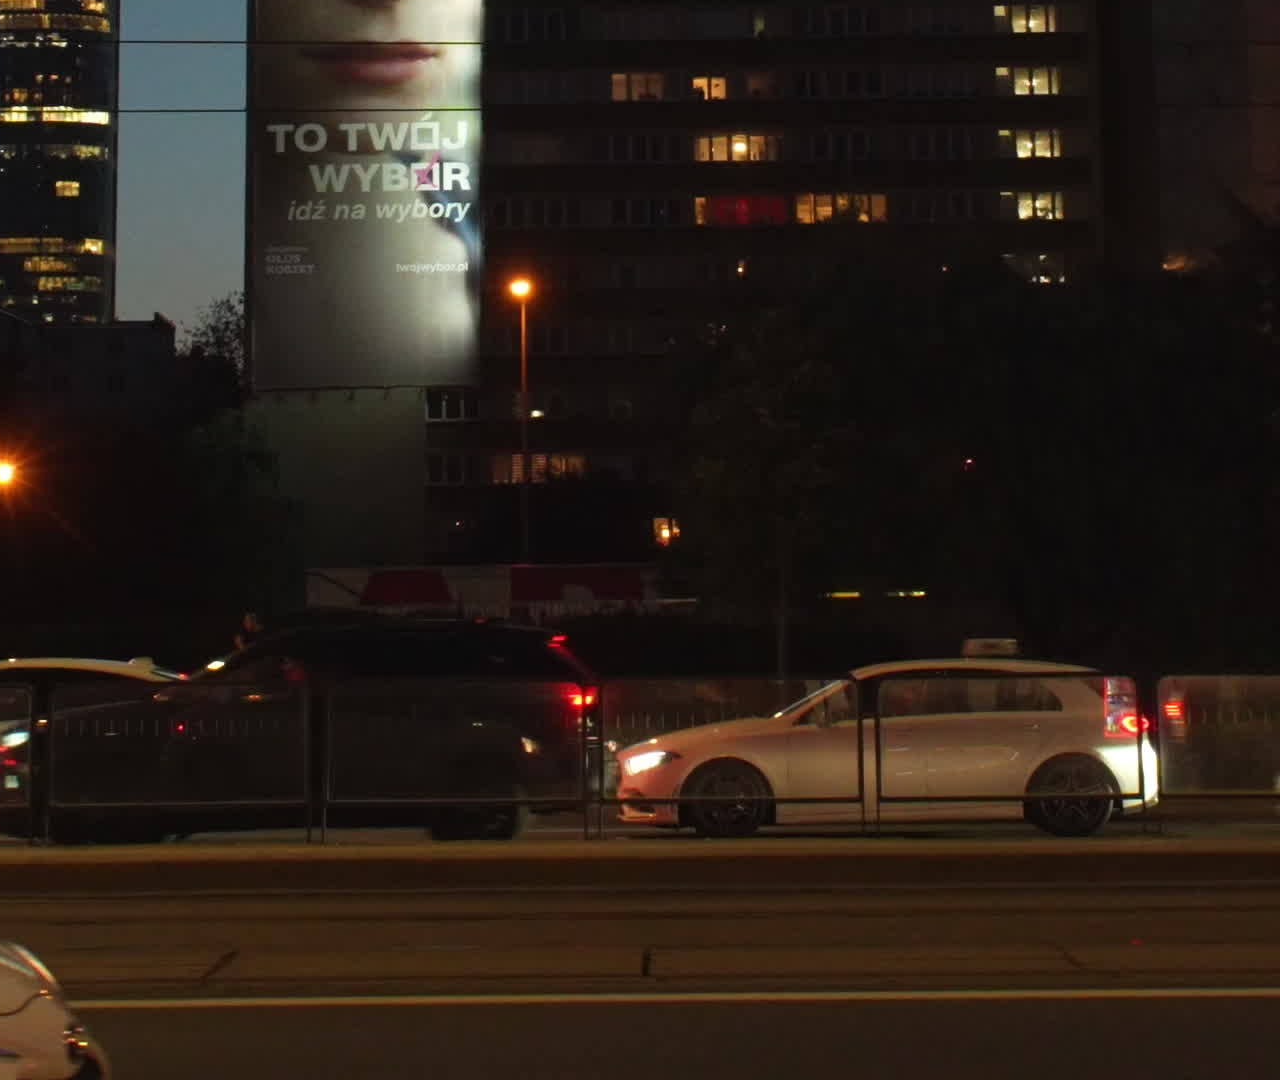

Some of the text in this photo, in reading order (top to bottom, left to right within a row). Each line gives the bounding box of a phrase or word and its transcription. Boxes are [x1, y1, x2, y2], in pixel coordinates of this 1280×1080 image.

[266, 112, 469, 153] TO TWÓJ
[287, 200, 472, 222] idź na wybory
